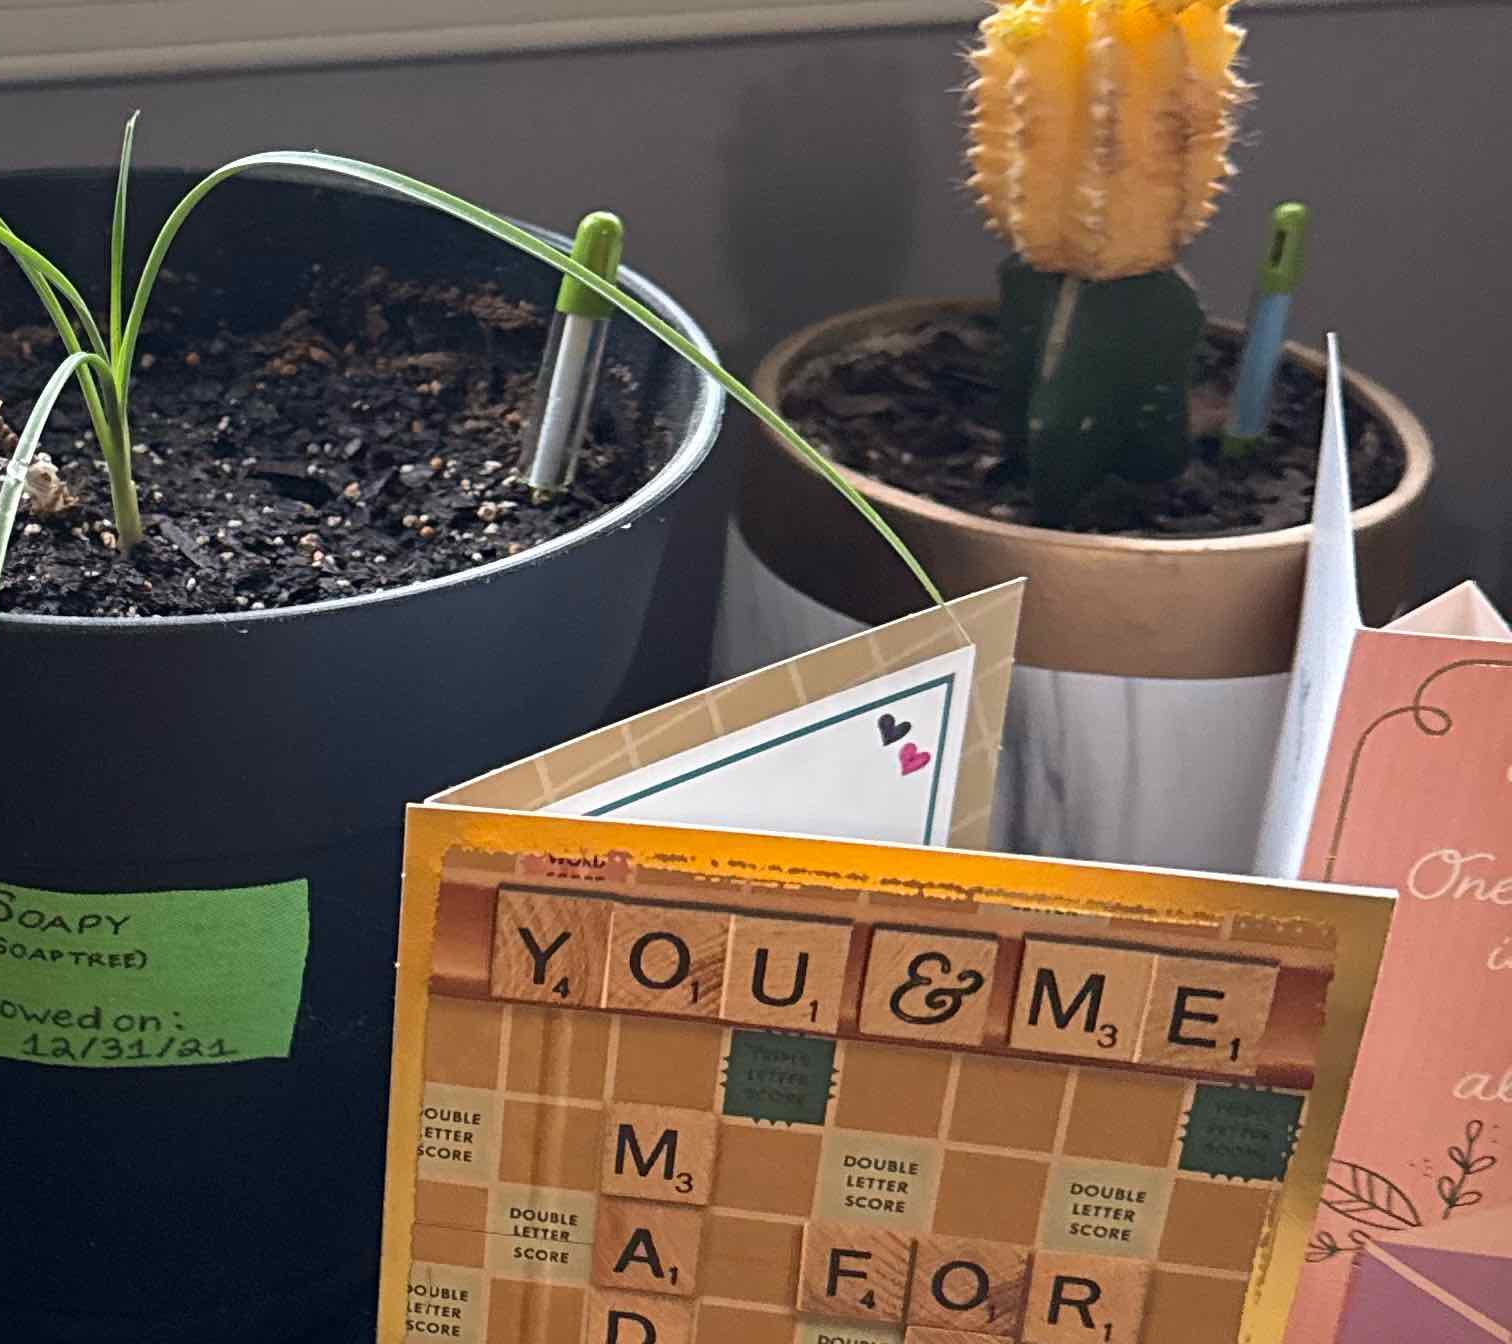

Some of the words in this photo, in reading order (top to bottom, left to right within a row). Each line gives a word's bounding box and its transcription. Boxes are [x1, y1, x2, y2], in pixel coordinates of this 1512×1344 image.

[1407, 847, 1512, 905] One
[1487, 936, 1512, 971] i
[889, 952, 985, 1026] &
[22, 1035, 237, 1061] 12/31/21
[419, 1107, 481, 1125] OUBLE
[419, 1126, 473, 1144] ETTER
[416, 1143, 473, 1162] SCORE
[844, 1155, 920, 1176] DOUBLE
[847, 1174, 909, 1194] LETTER
[1070, 1182, 1147, 1204] DOUBLE
[844, 1195, 906, 1213] SCORE
[1072, 1203, 1136, 1223] LETTER
[510, 1207, 579, 1227] DOUBLE
[513, 1225, 571, 1243] LETTER
[1069, 1222, 1132, 1242] SCORE
[513, 1246, 570, 1265] SCORE
[406, 1319, 461, 1337] SCORE
